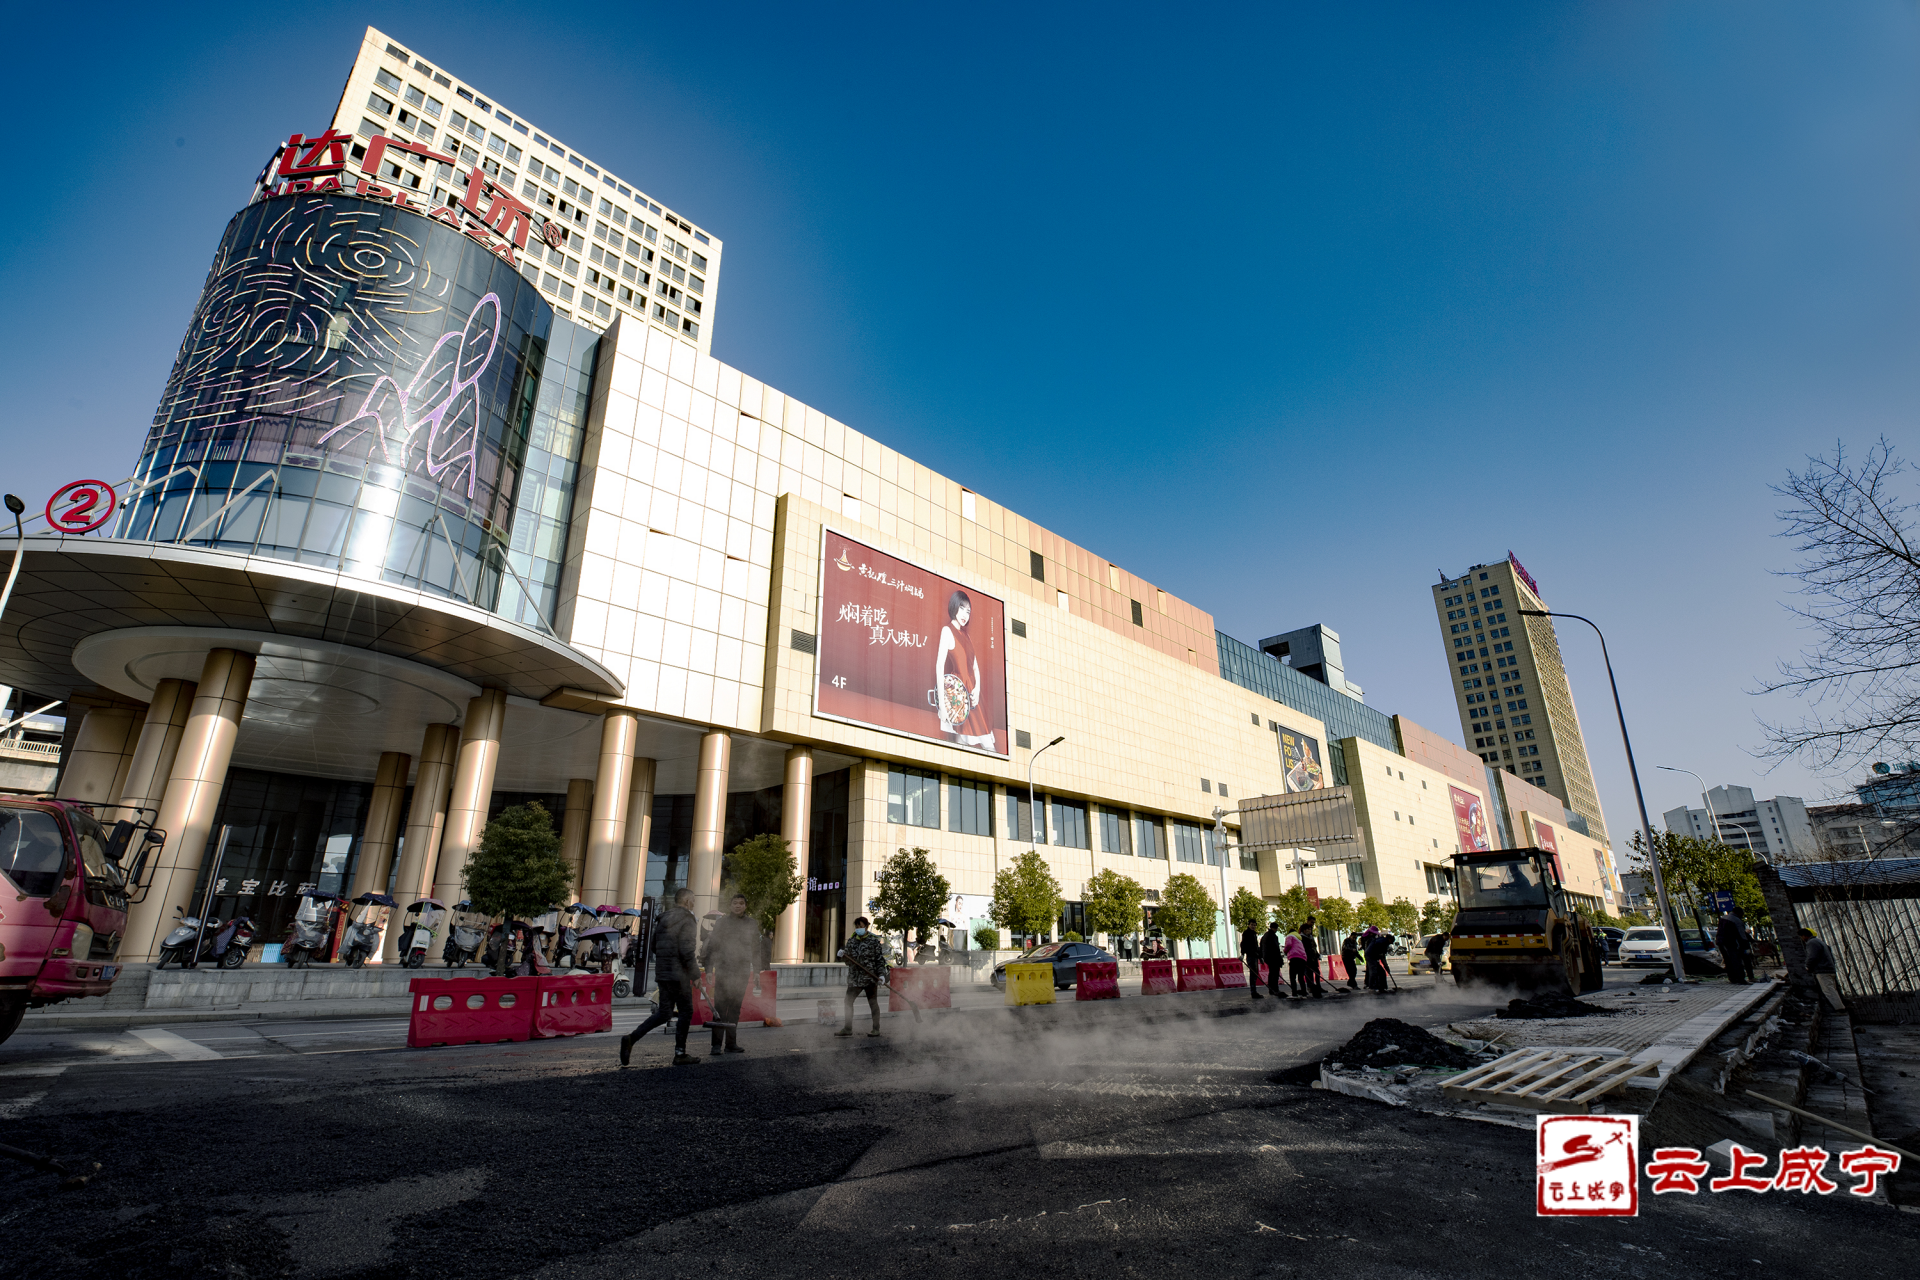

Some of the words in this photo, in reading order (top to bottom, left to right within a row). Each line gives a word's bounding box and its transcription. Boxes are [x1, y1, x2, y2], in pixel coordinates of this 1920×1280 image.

[278, 129, 532, 249] 达广场
[356, 179, 517, 267] PLAZA
[836, 601, 889, 626] 焖着吃
[831, 675, 847, 689] 4F
[1282, 733, 1295, 746] NEW
